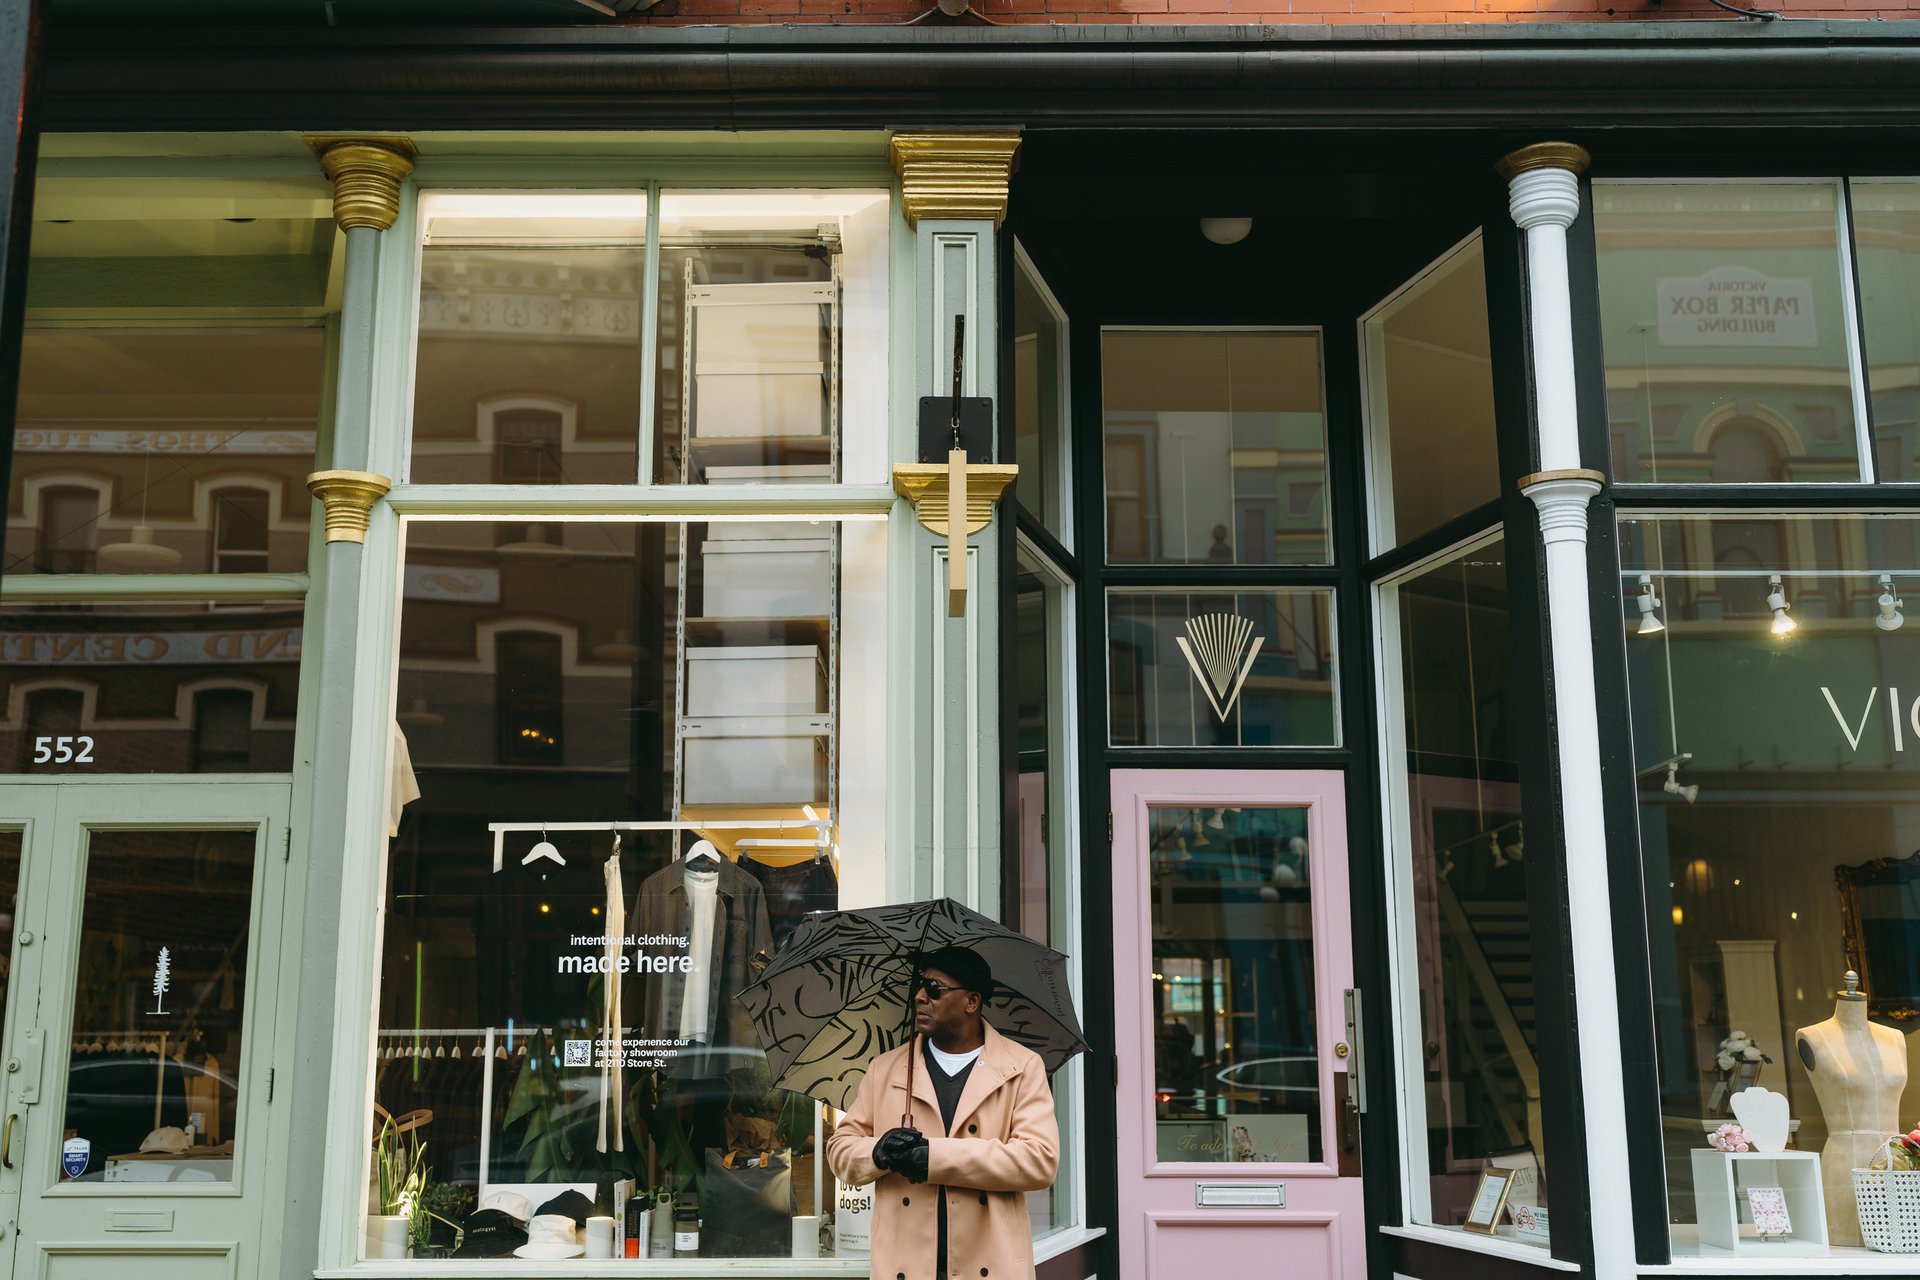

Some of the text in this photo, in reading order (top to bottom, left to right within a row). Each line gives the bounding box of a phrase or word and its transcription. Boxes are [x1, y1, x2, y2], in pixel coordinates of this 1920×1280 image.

[1820, 686, 1920, 752] VI
[34, 736, 94, 763] 552
[570, 934, 690, 948] intentional clothing.
[558, 949, 701, 974] made here.
[595, 1039, 690, 1049] come experience our
[595, 1048, 678, 1058] factory showroom
[594, 1059, 605, 1068] at
[627, 1058, 652, 1068] Store
[653, 1058, 667, 1068] St.
[839, 1194, 871, 1214] dogs!
